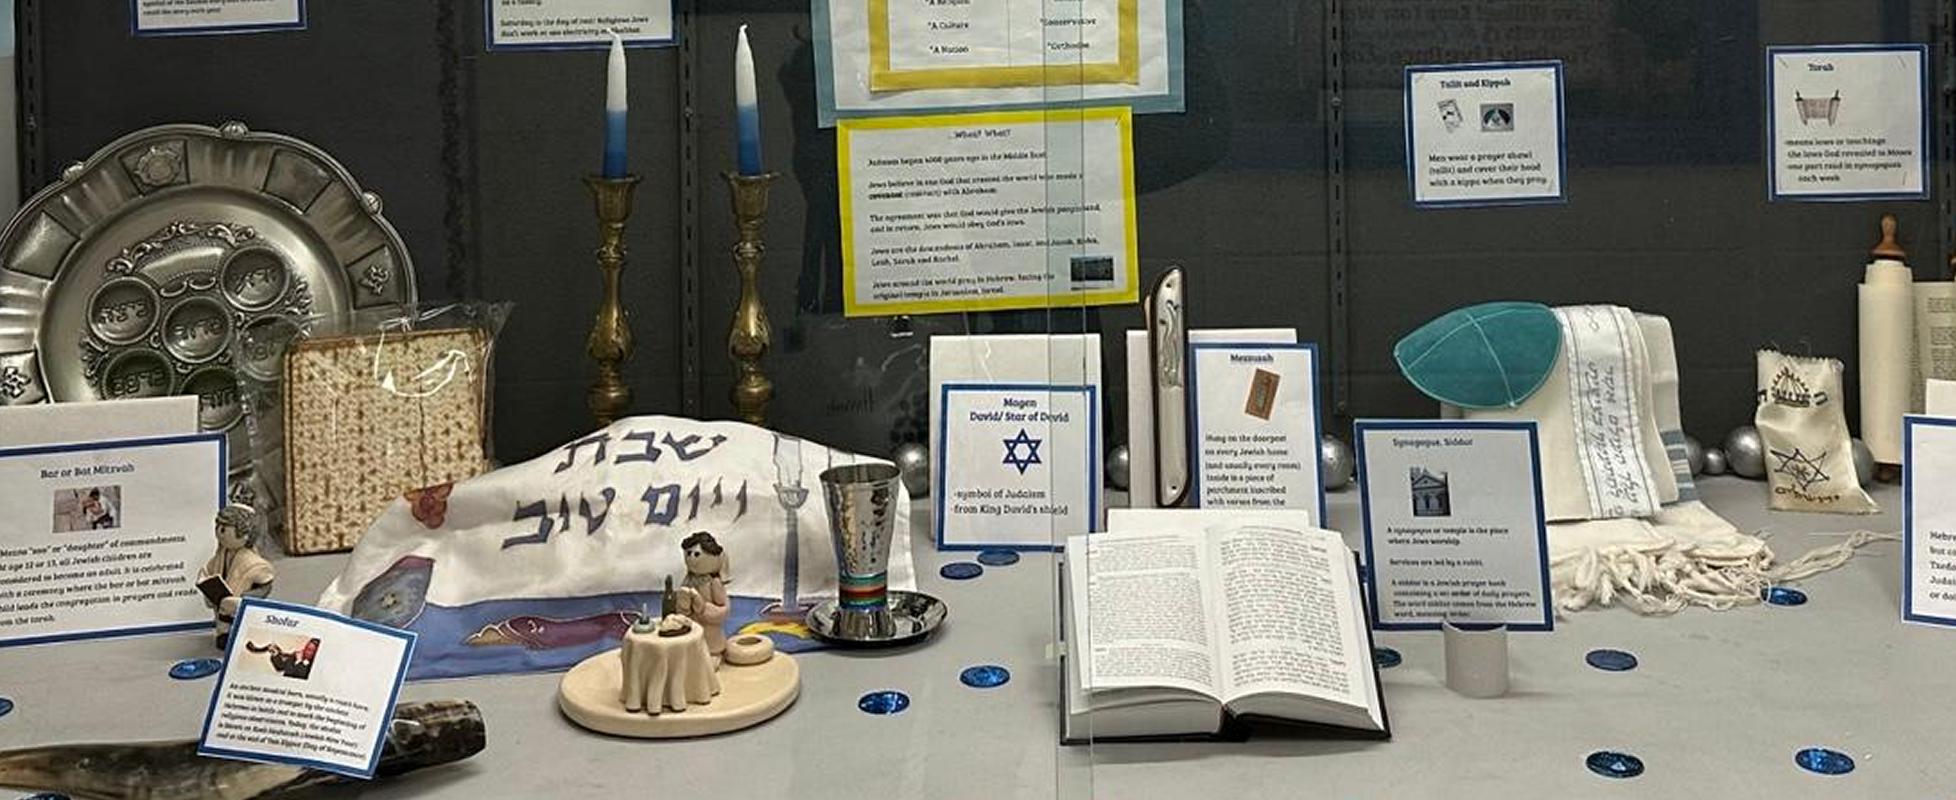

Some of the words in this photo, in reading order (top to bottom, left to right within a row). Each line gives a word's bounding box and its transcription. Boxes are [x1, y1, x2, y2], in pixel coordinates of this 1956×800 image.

[1808, 63, 1833, 71] Torah
[1003, 398, 1036, 409] Magen
[1005, 411, 1026, 421] Star
[1027, 411, 1038, 421] of
[1039, 412, 1069, 422] David
[554, 428, 727, 474] שבת
[40, 468, 59, 478] Bar
[60, 469, 71, 477] or
[74, 466, 91, 476] Bat
[93, 463, 134, 474] Mitzvah
[500, 486, 617, 550] טוב
[265, 614, 299, 627] Shofar
